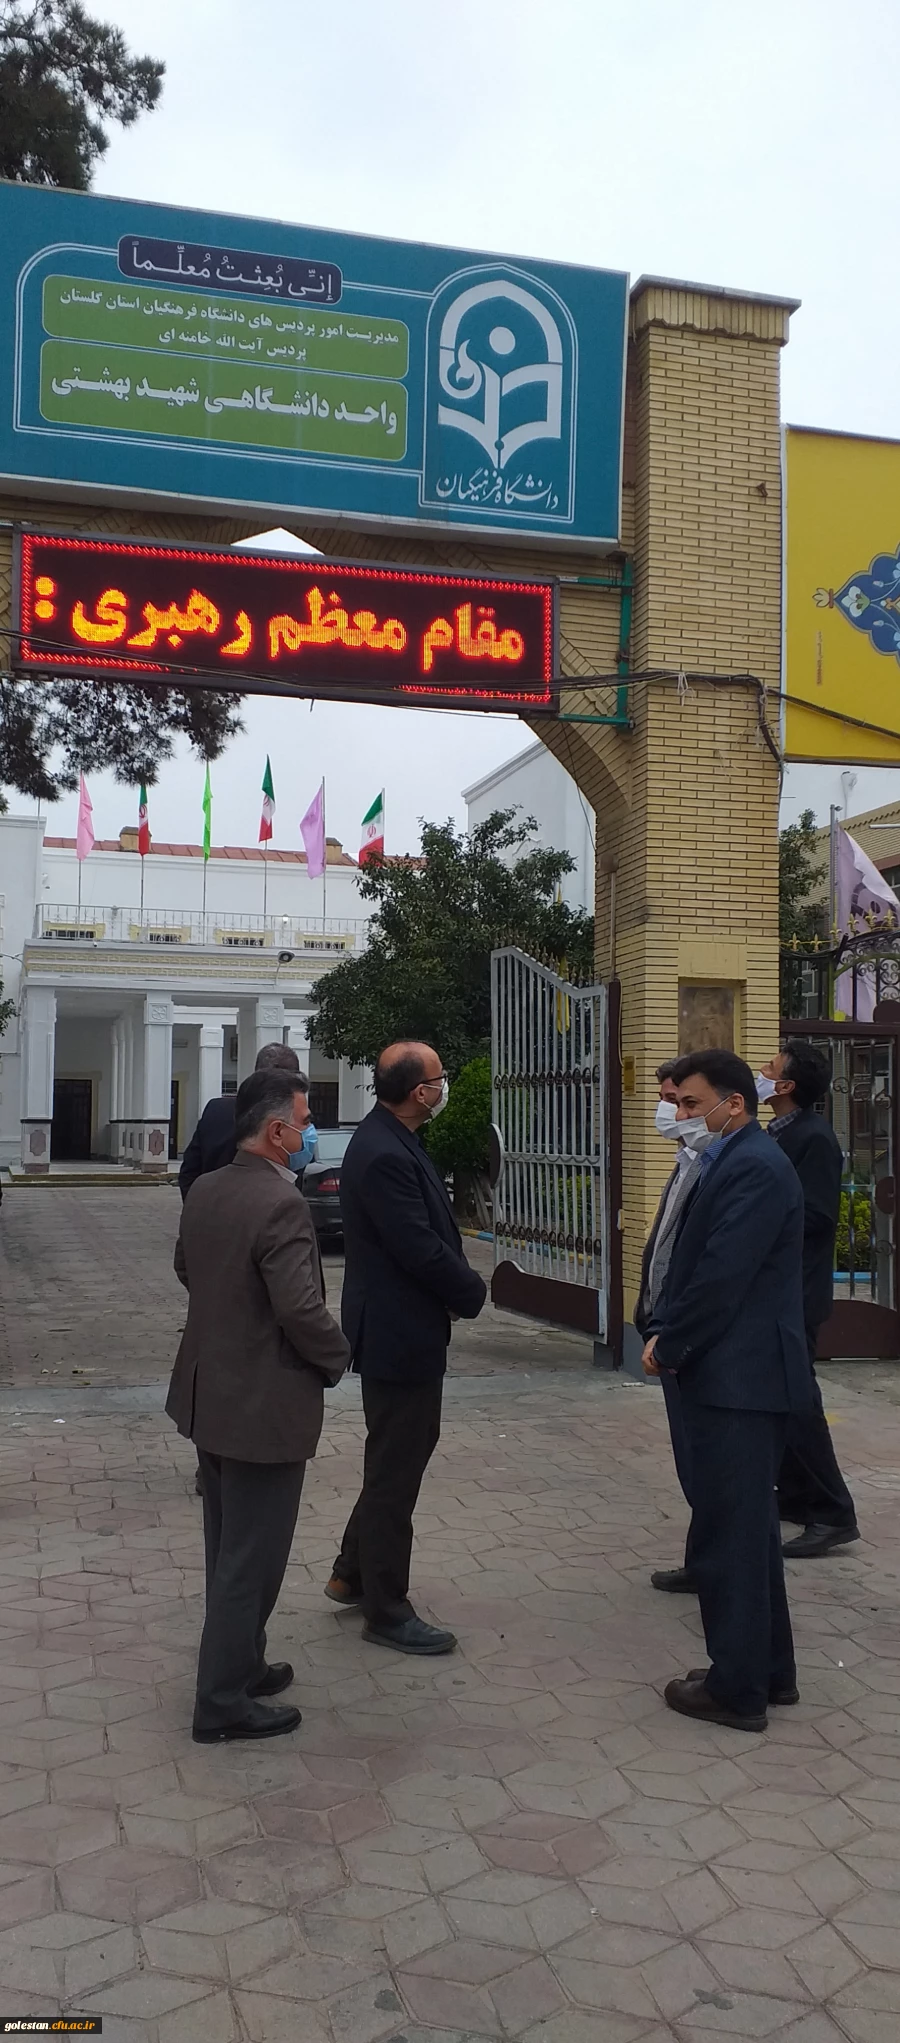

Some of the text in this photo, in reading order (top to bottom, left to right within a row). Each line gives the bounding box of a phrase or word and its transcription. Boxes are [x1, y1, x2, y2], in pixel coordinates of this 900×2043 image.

[60, 288, 102, 304] گلستان
[105, 294, 140, 309] استان
[143, 299, 197, 320] فرهنگیان
[200, 306, 245, 323] دانشگاه
[248, 313, 272, 328] های
[158, 328, 175, 343] ای
[178, 330, 212, 344] خامنه
[319, 324, 343, 338] امور
[346, 327, 399, 345] مدیریت
[238, 337, 264, 354] آیت
[266, 344, 307, 362] پردیس
[51, 366, 397, 434] واحد دانشگاهی شهید بهشتی
[494, 473, 559, 510] دانشگاه
[72, 587, 253, 659] رهبری
[269, 585, 408, 660] معظم
[422, 602, 525, 673] مقام
